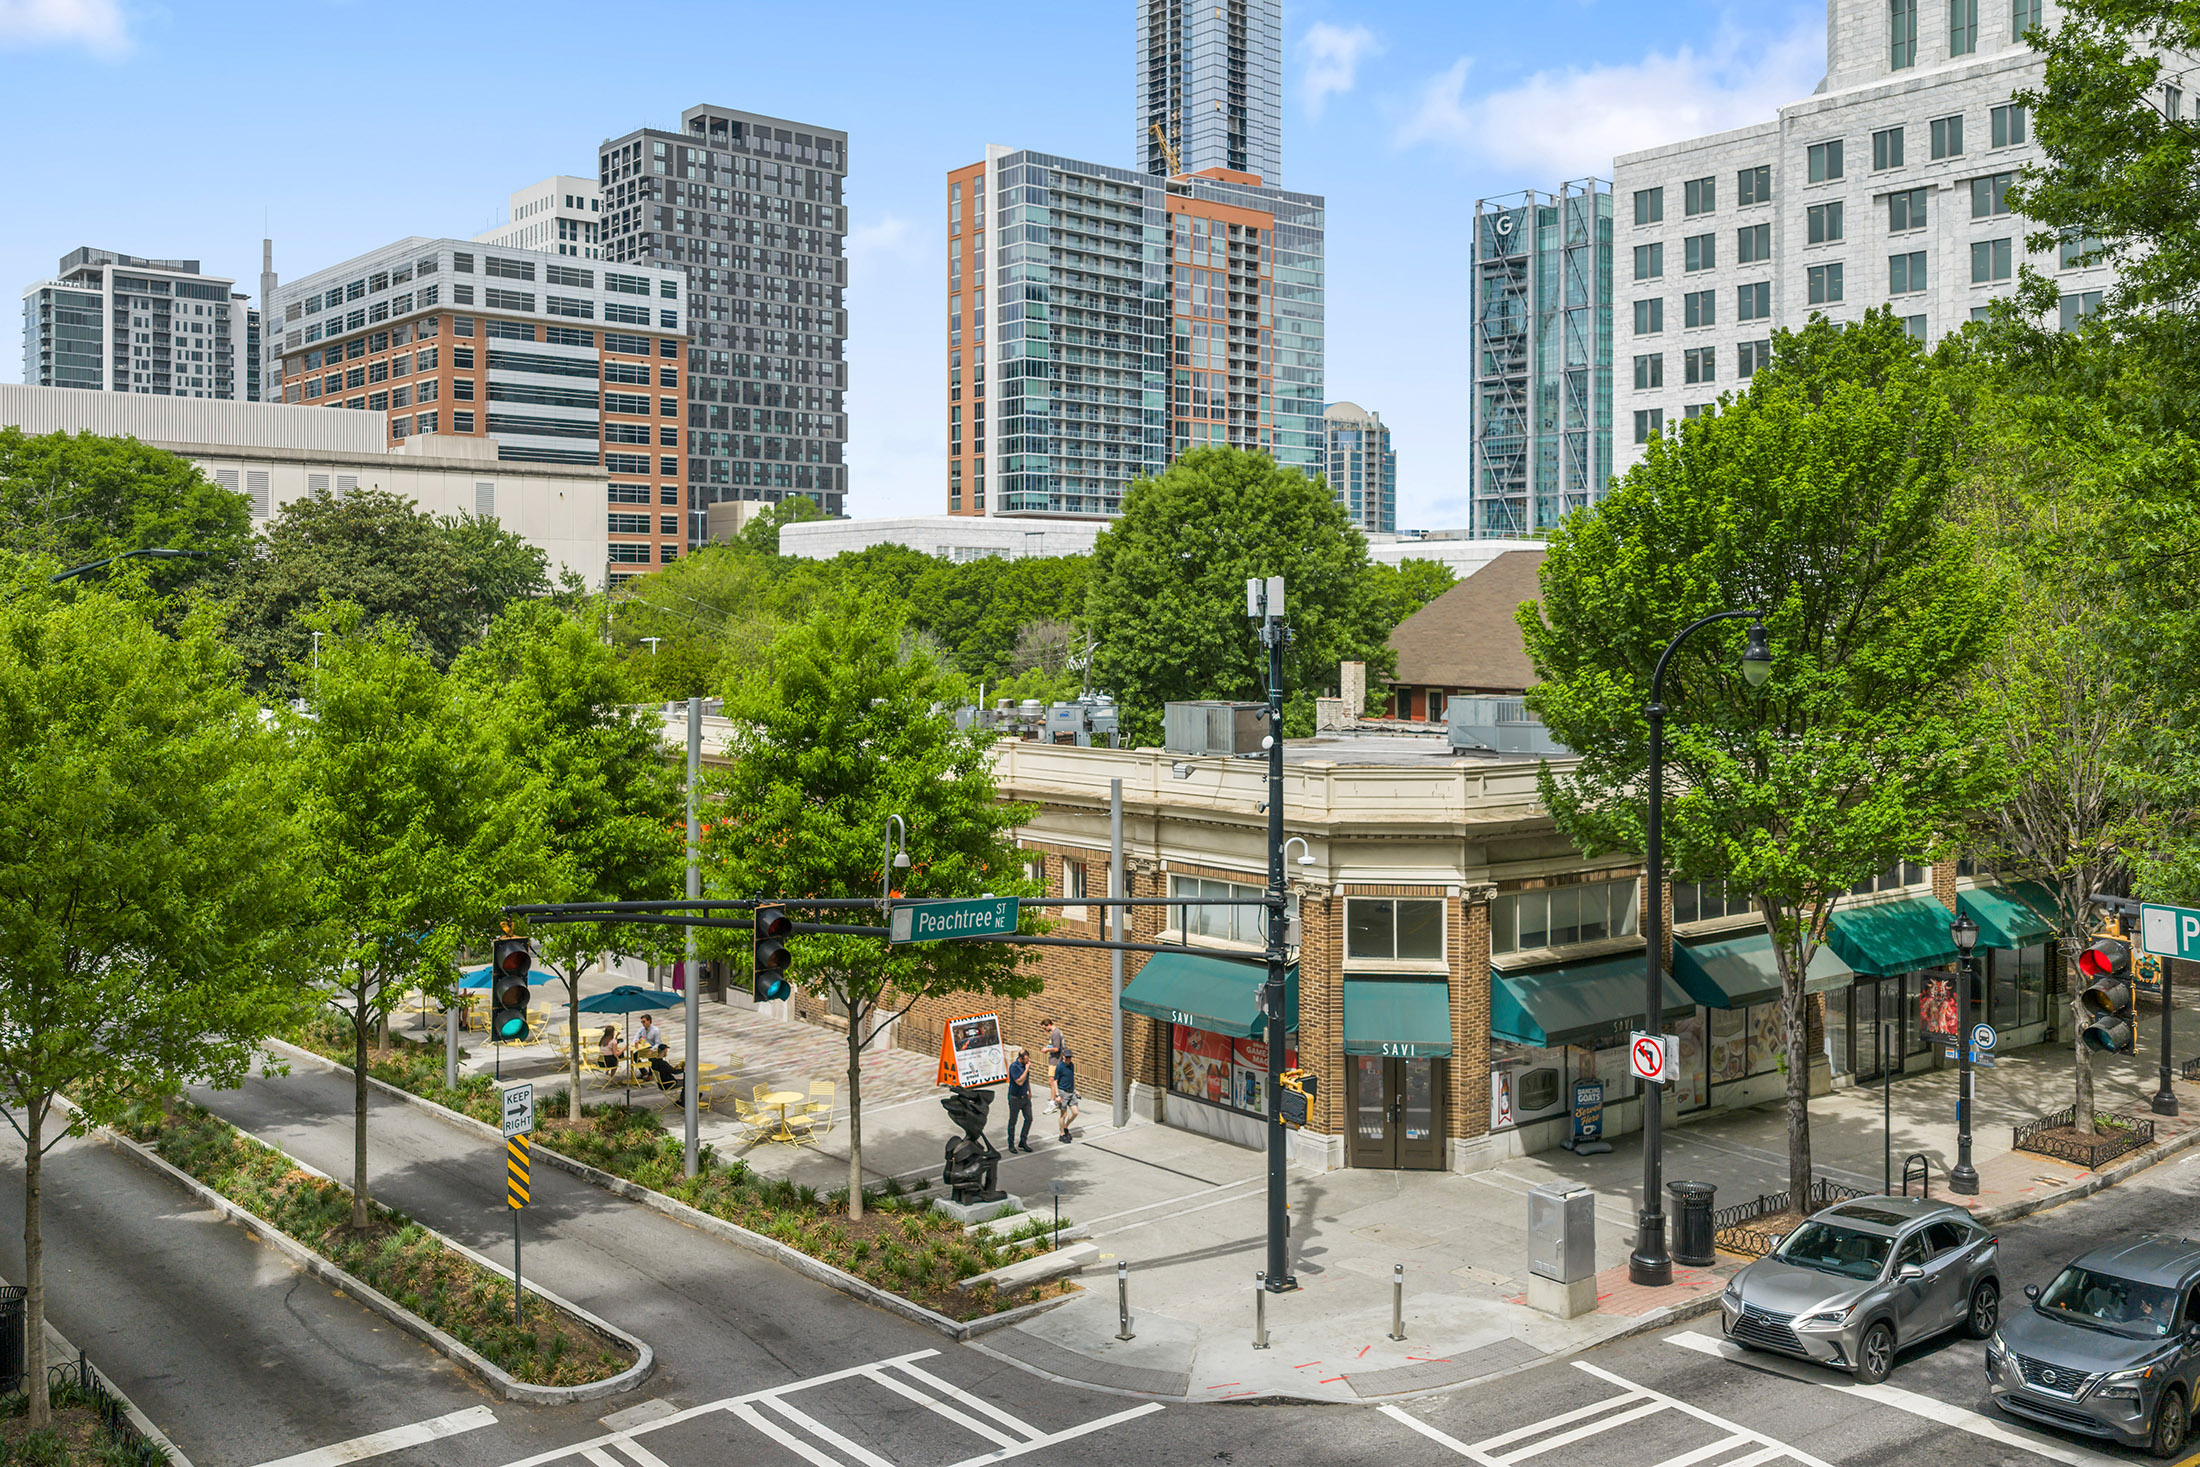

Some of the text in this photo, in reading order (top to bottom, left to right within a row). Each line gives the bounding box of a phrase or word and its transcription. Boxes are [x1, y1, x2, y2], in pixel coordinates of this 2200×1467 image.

[1497, 216, 1513, 235] G
[919, 902, 1007, 933] Peachtree ST
[995, 917, 1006, 928] NE
[1172, 1010, 1193, 1026] SAVI
[1613, 1018, 1634, 1033] SAVI
[1382, 1043, 1415, 1057] SAVI
[507, 1091, 530, 1104] KEEP
[1577, 1094, 1601, 1102] GOATS
[1576, 1102, 1602, 1117] Served
[506, 1116, 531, 1131] RIGHT
[1580, 1114, 1600, 1126] Here
